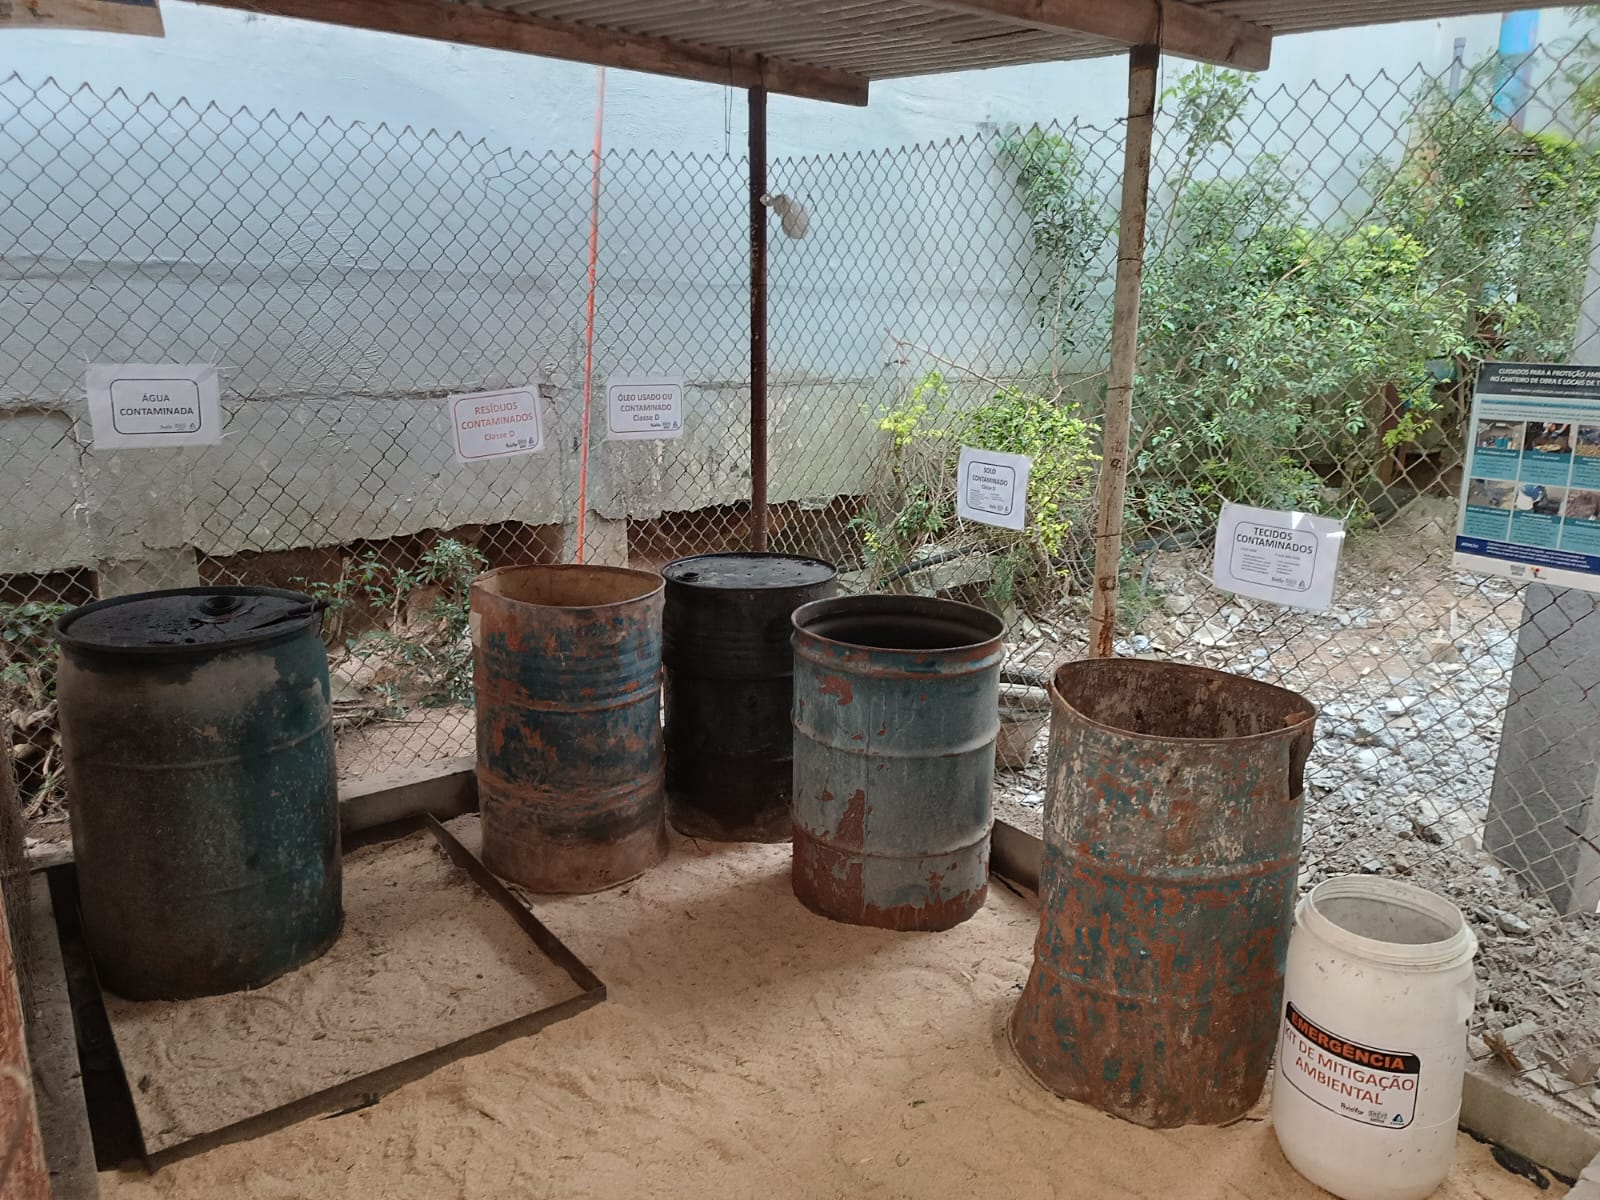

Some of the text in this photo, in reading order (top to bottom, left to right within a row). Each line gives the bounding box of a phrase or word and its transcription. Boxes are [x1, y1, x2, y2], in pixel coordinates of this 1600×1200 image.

[1530, 377, 1539, 385] DE
[142, 393, 171, 403] ÁGUA
[617, 393, 673, 402] ÓLEO USADO OU
[119, 407, 194, 416] CONTAMINADA
[474, 401, 518, 415] RESÍDUOS
[620, 403, 672, 412] CONTAMINADO
[461, 413, 534, 430] CONTAMINADOS
[633, 414, 653, 422] Classe
[484, 430, 515, 441] Classe D
[972, 475, 1008, 486] CONTAMINADO
[1254, 527, 1293, 541] TECIDOS
[1236, 534, 1313, 554] CONTAMINADOS
[1291, 1011, 1405, 1070] EMERGÊNCIA
[1299, 1039, 1316, 1060] DE
[1318, 1053, 1415, 1092] MITIGAÇÃO
[1295, 1056, 1383, 1105] AMBIENTAL
